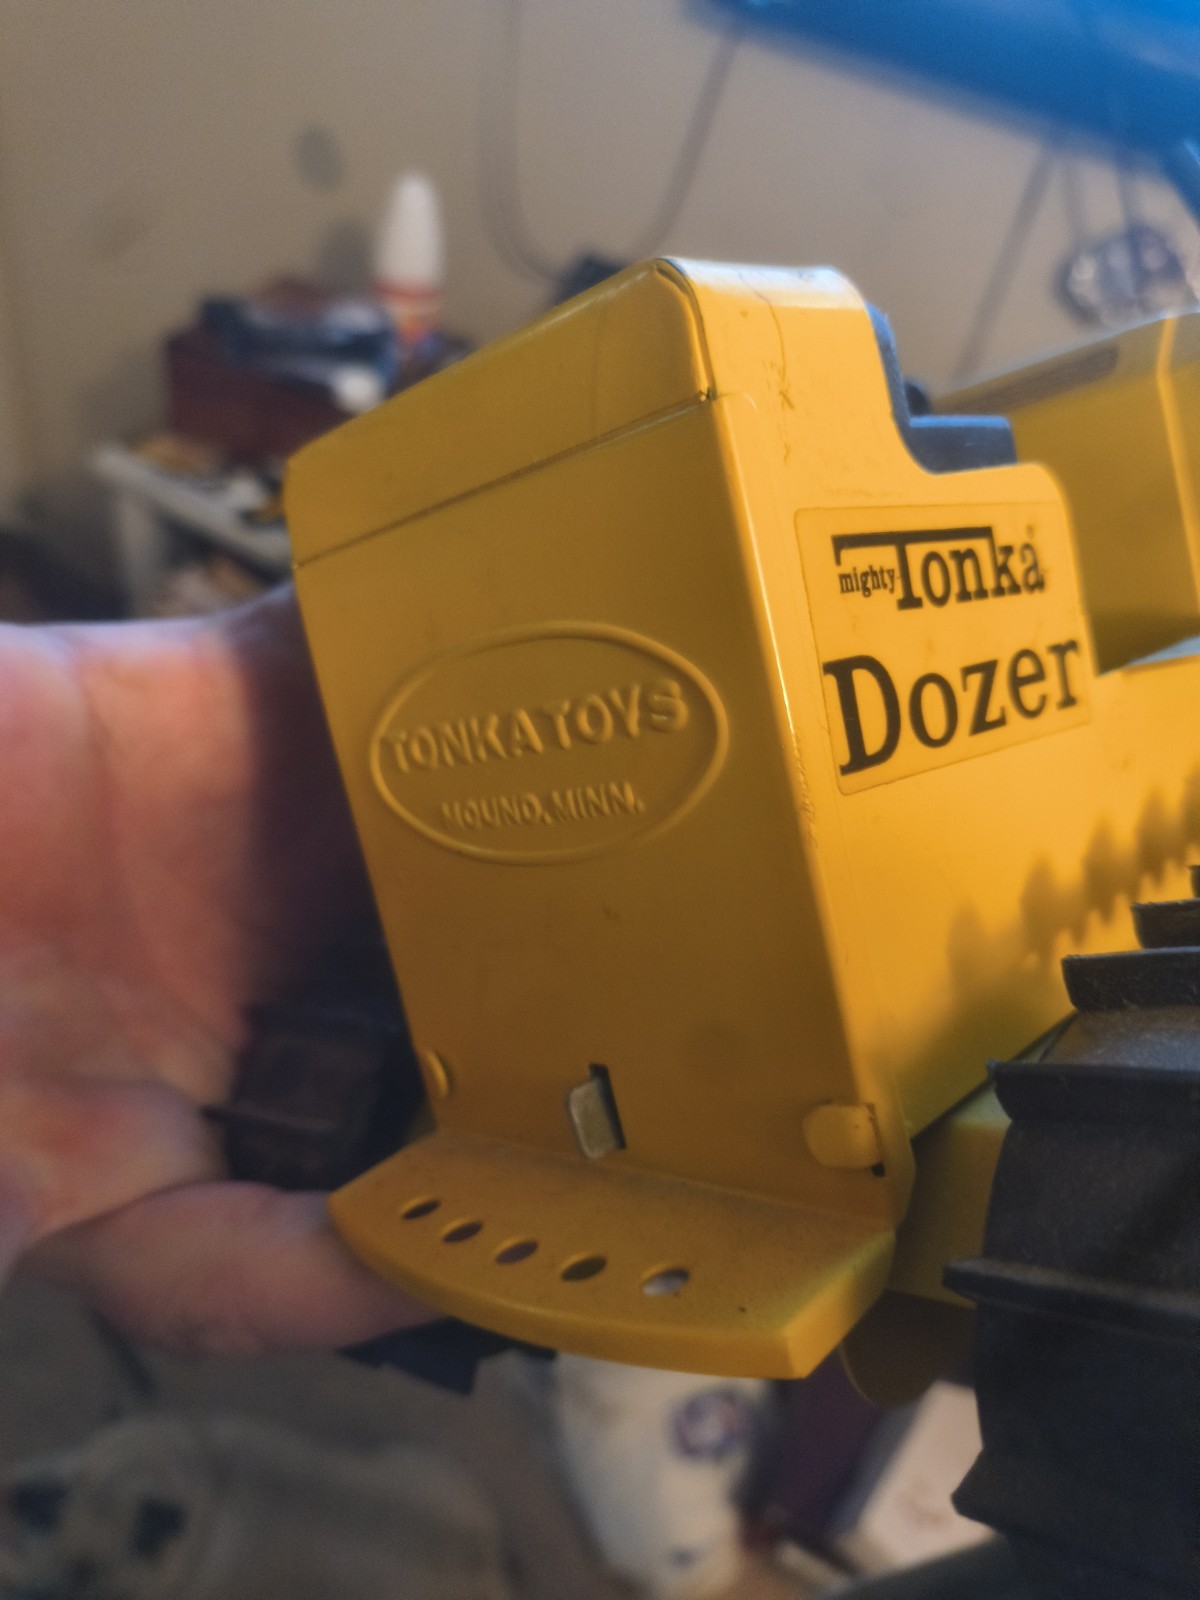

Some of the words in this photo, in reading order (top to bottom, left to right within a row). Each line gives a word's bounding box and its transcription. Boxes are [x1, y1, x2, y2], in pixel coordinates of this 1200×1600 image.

[831, 526, 1046, 611] Tonka
[386, 707, 544, 774] TONKA
[542, 677, 690, 750] TOYS
[822, 639, 1079, 777] Dozer
